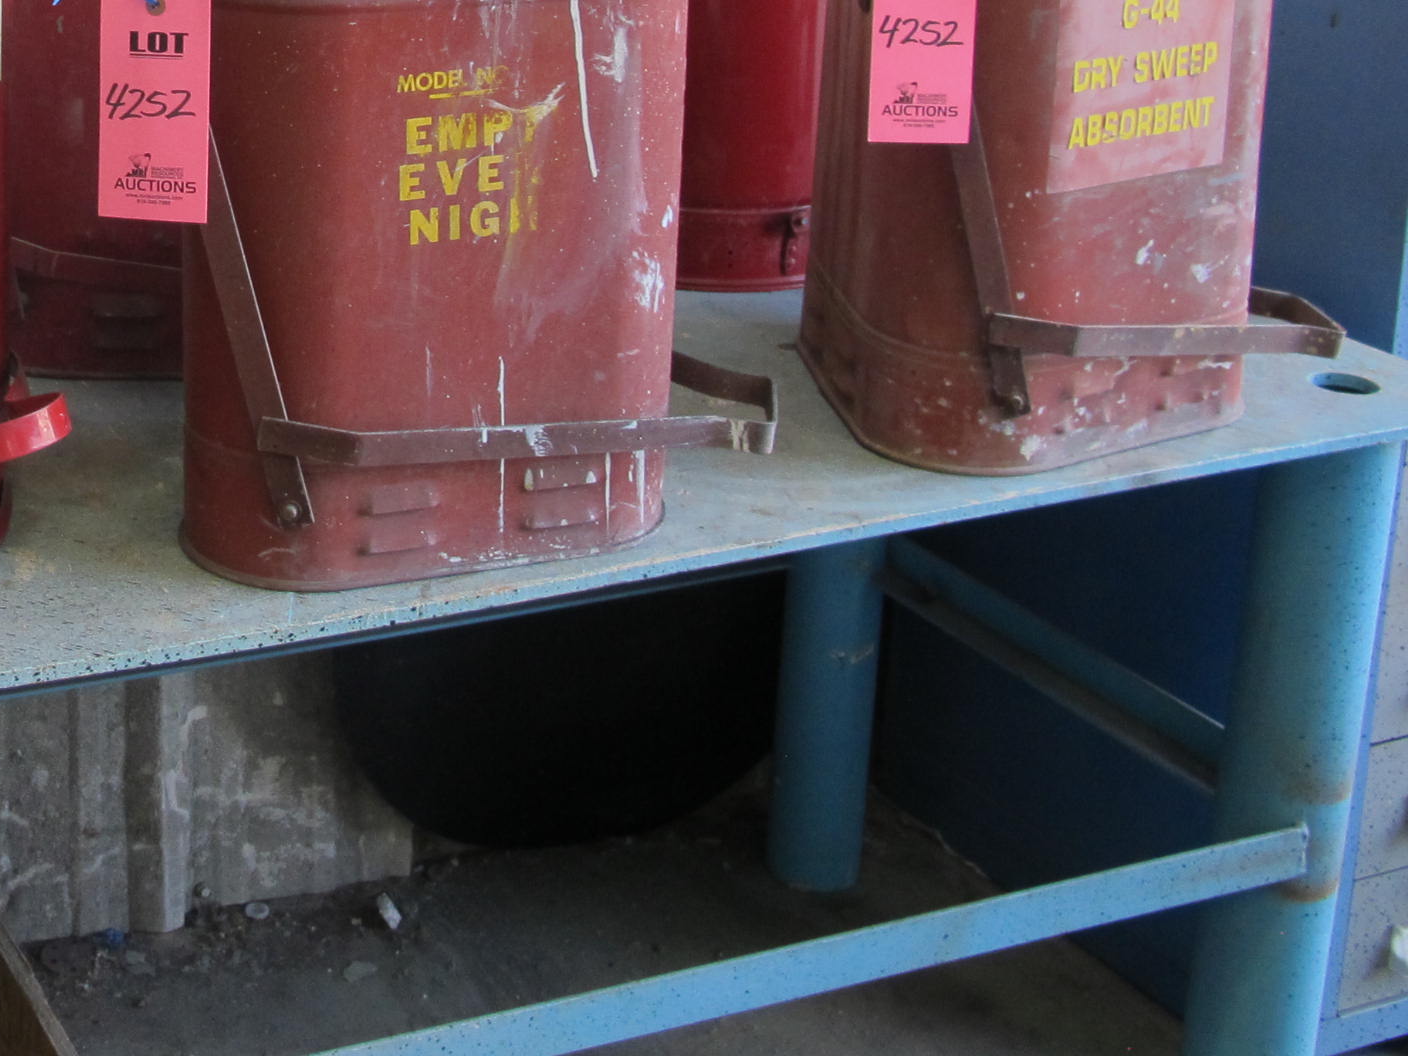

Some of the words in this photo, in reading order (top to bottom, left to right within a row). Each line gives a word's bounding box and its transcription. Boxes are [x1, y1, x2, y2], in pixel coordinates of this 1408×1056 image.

[130, 31, 189, 54] LOT
[879, 15, 964, 48] 4252
[1134, 41, 1219, 83] SWEEP
[397, 68, 467, 93] MODEL
[105, 83, 196, 120] 4252
[882, 105, 958, 117] AUCTIONS
[1068, 96, 1216, 150] ABSORBENT
[114, 178, 197, 194] AUCTIONS
